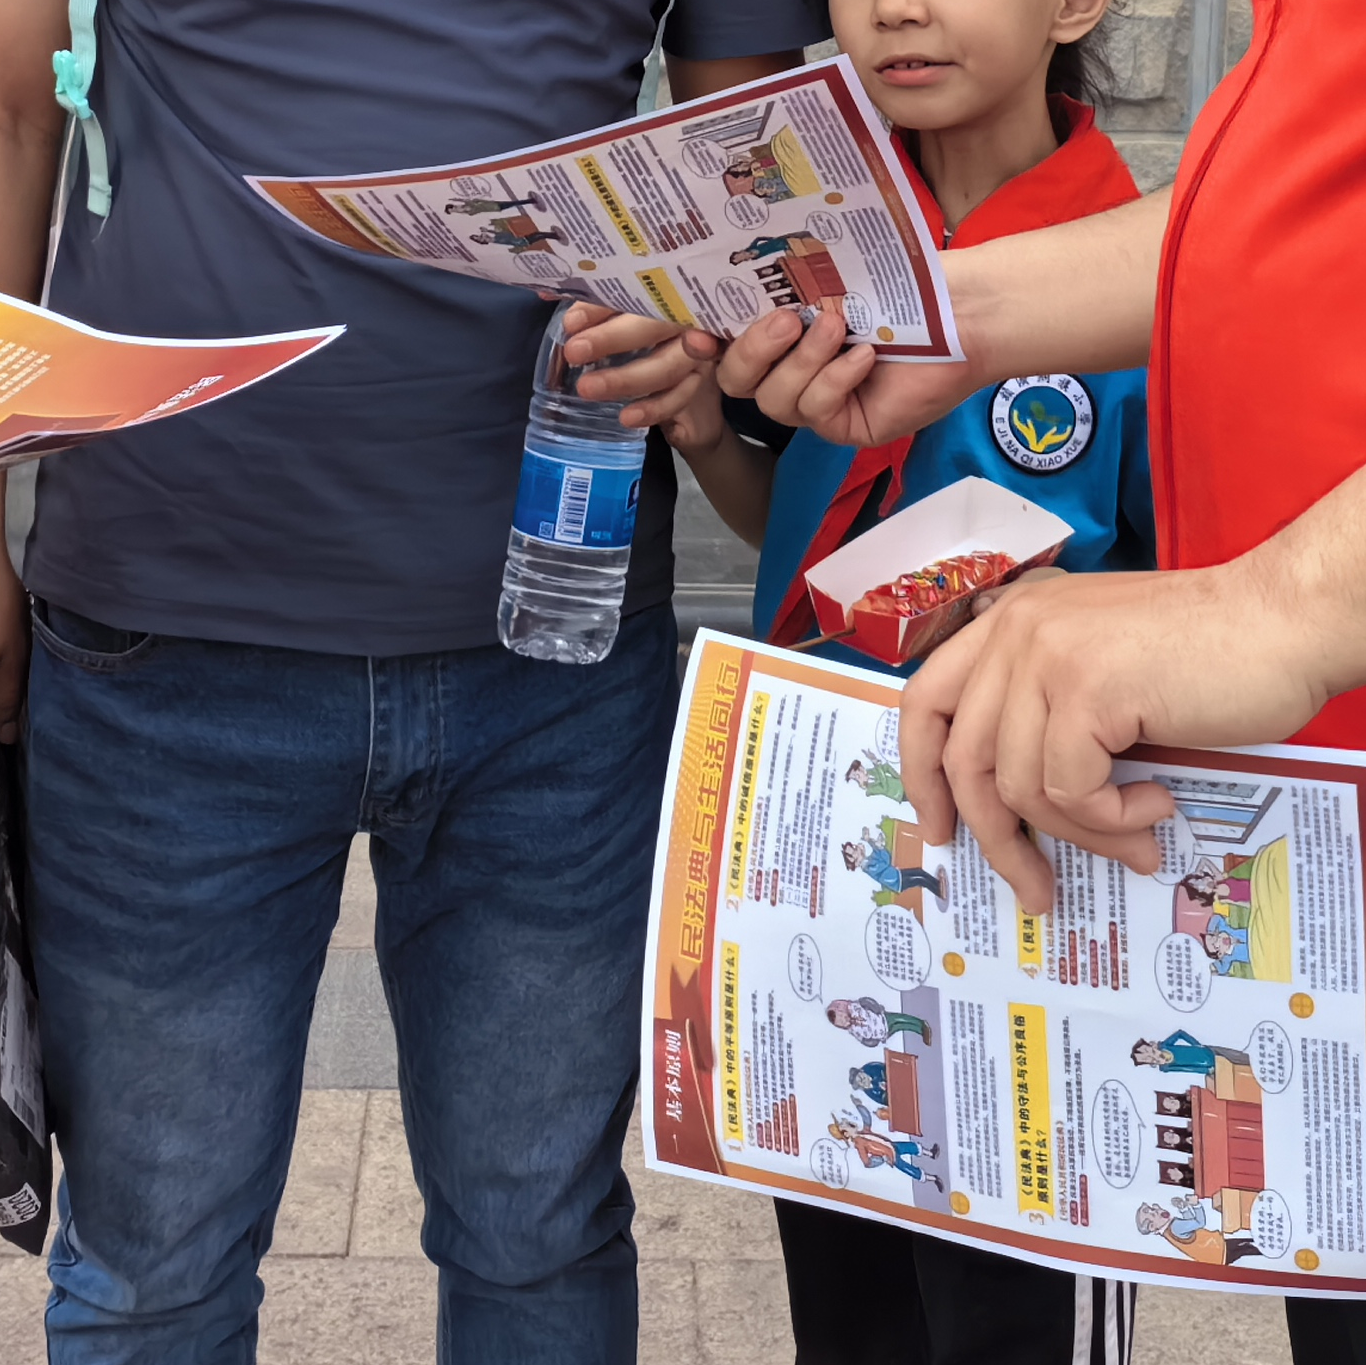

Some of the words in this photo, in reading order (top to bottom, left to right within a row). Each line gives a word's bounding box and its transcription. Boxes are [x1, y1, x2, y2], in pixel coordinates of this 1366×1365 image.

[678, 659, 742, 964] 民法典与生活同行
[1021, 906, 1036, 956] 《民法
[663, 1030, 684, 1123] 基本原则
[1012, 1013, 1033, 1198] 《民法典》中的守法与公序良俗
[1035, 1129, 1050, 1204] 原则是什么?
